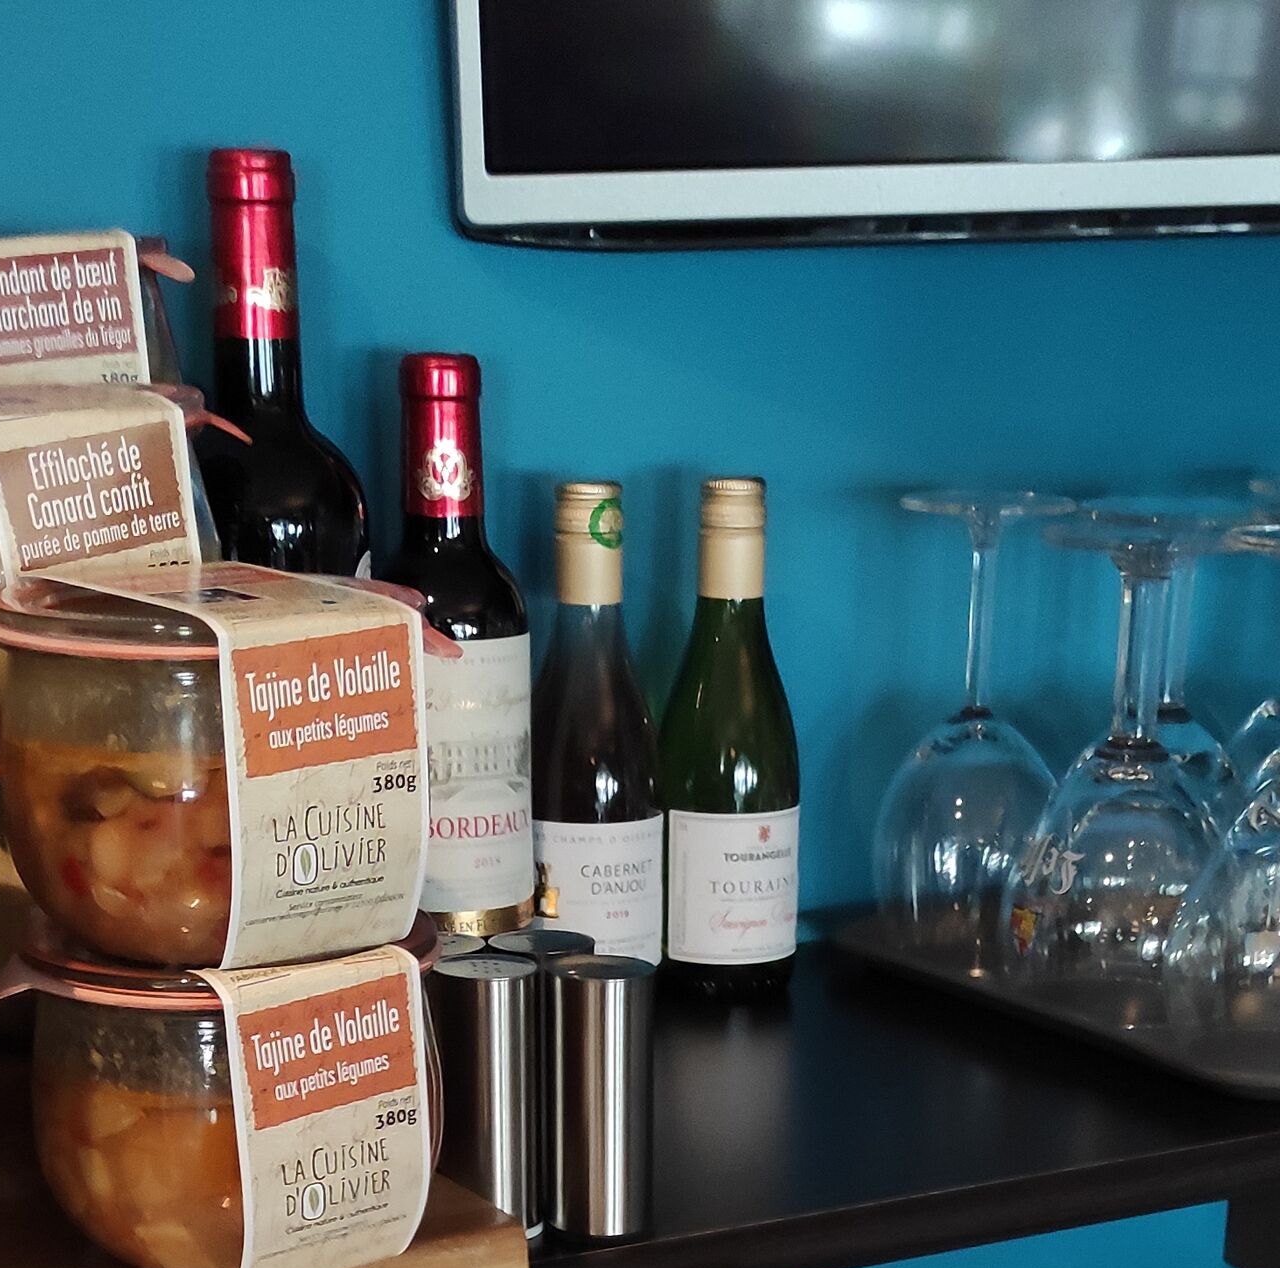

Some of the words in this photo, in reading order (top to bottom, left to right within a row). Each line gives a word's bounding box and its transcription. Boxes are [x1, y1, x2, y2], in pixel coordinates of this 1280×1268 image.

[50, 256, 72, 291] de
[73, 250, 118, 289] bœuf
[72, 289, 94, 325] de
[96, 289, 122, 322] vin
[85, 327, 100, 348] du
[100, 324, 131, 350] Trégor
[27, 441, 115, 491] Effiloché
[116, 435, 142, 473] de
[27, 481, 98, 531] Canard
[99, 472, 154, 516] confit
[21, 534, 61, 567] purée
[63, 529, 81, 553] de
[84, 524, 129, 554] pomme
[131, 514, 148, 537] de
[148, 511, 181, 534] terre
[245, 671, 303, 722] Tajine
[307, 662, 331, 703] de
[333, 649, 401, 699] Volaille
[269, 730, 294, 749] aux
[294, 717, 334, 751] petits
[334, 710, 389, 741] légumes
[373, 774, 417, 793] 380g
[272, 815, 297, 843] LA
[304, 802, 387, 842] CUISINE
[580, 858, 652, 879] CABERNET
[591, 878, 647, 896] D'ANJOU
[709, 873, 795, 895] TOURAIN
[250, 1030, 306, 1076] Tajine
[309, 1017, 333, 1055] de
[333, 998, 401, 1048] Volaille
[274, 1079, 299, 1101] aux
[299, 1067, 336, 1100] petits
[336, 1053, 390, 1085] légumes
[375, 1108, 418, 1130] 380g
[281, 1159, 306, 1186] LA
[312, 1137, 391, 1181] CUISINE
